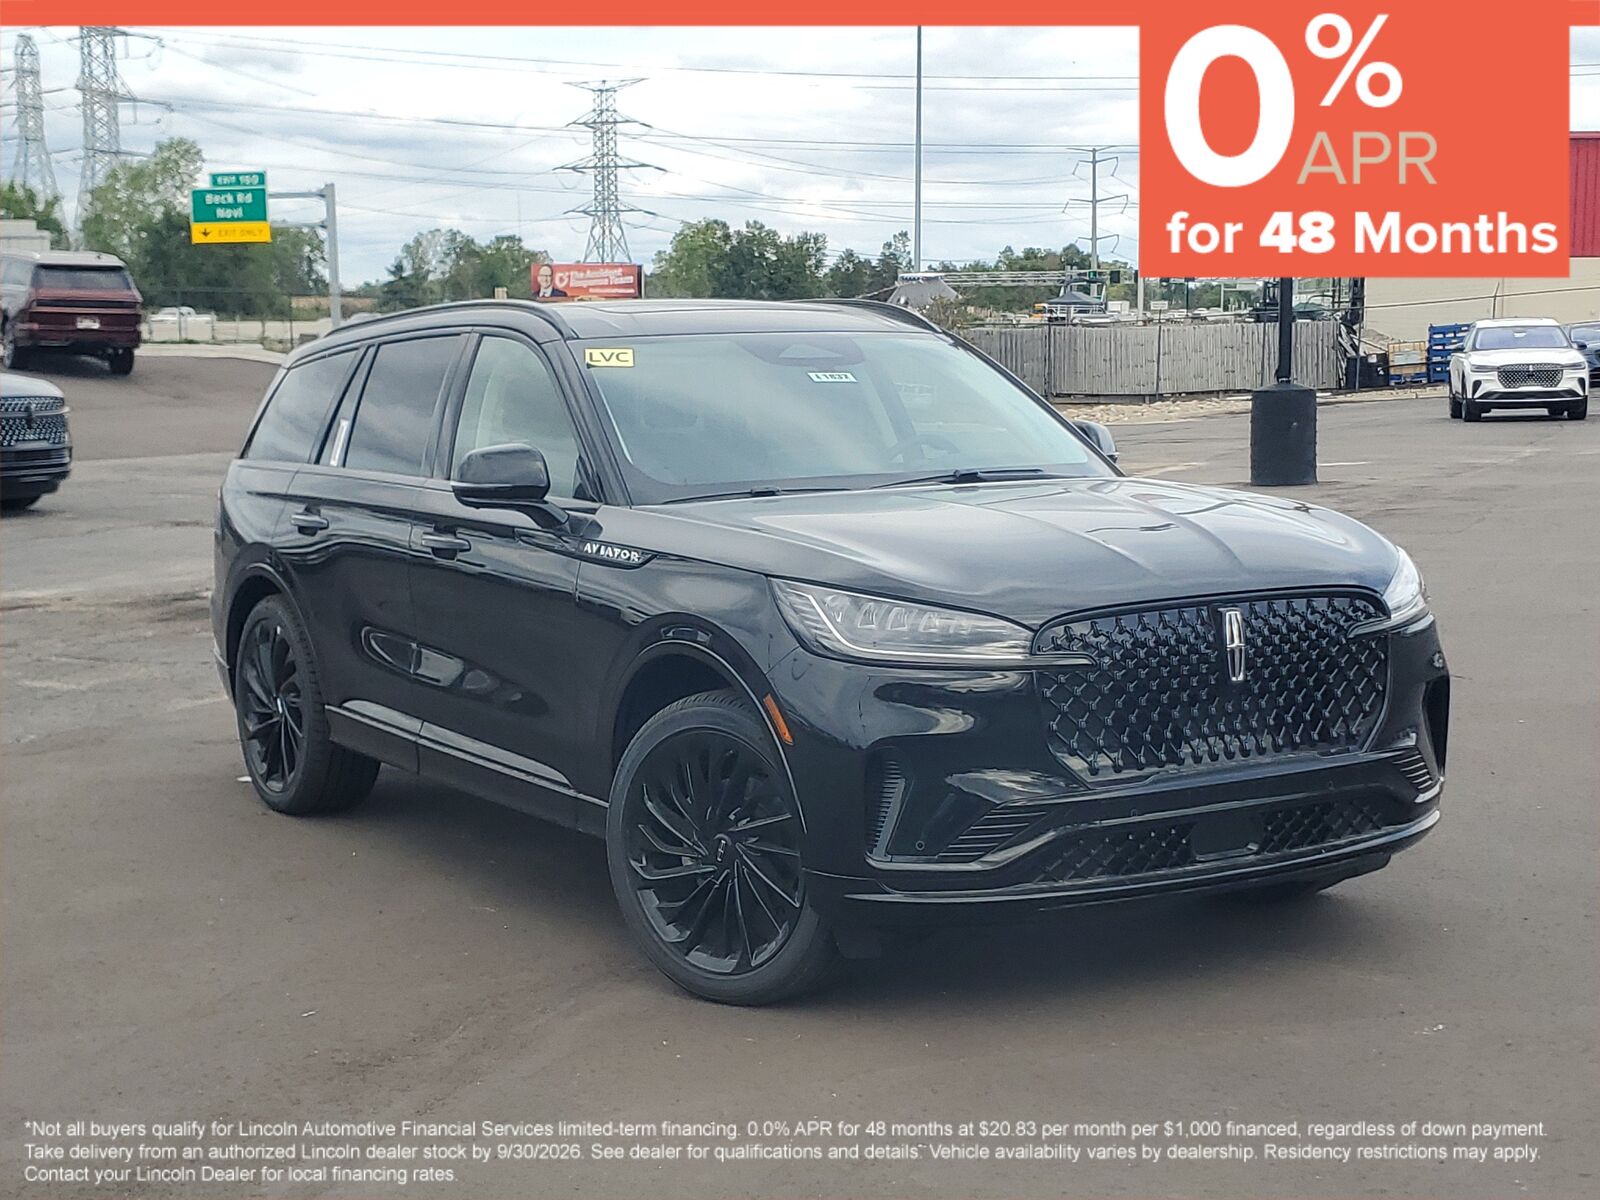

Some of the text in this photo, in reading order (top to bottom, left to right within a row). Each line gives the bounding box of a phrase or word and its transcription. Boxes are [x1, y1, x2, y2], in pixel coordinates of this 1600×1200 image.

[205, 191, 253, 204] Beck Rd
[216, 207, 243, 218] Novi
[589, 351, 630, 363] LVC
[583, 542, 640, 562] AVIATOR
